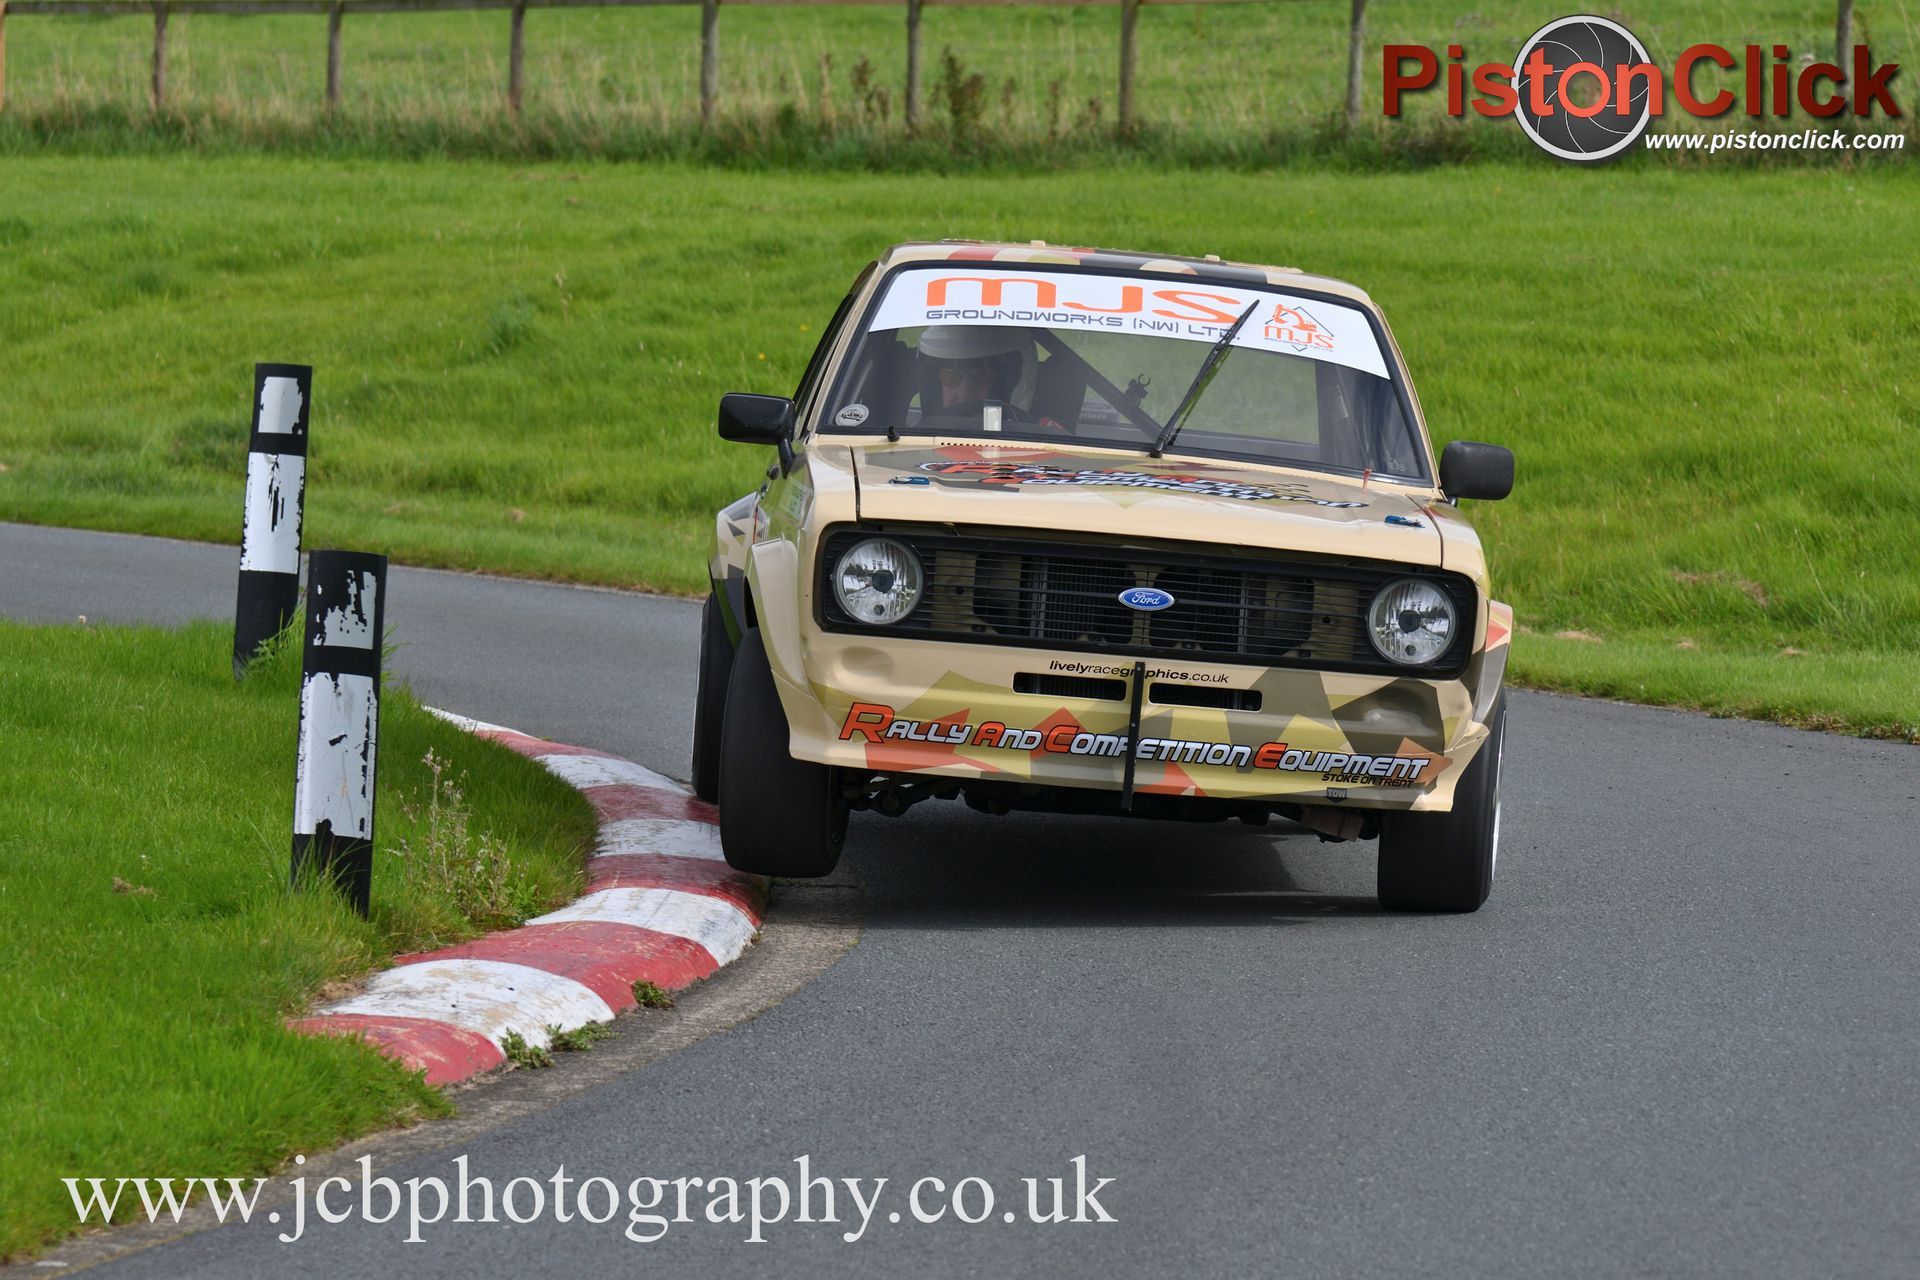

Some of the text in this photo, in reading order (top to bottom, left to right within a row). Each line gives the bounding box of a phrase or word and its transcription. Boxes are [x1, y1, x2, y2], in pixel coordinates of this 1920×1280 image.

[926, 309, 1123, 326] GROUNDWORKS
[1133, 317, 1179, 334] (NW)
[1131, 591, 1161, 605] Ford
[1049, 660, 1229, 684] livelyracegrphics.co.uk
[839, 702, 972, 744] RALLY
[1253, 742, 1431, 780] EQUIPMENT
[1321, 773, 1415, 788] STOKE ON TRENT
[1327, 788, 1346, 798] TOW
